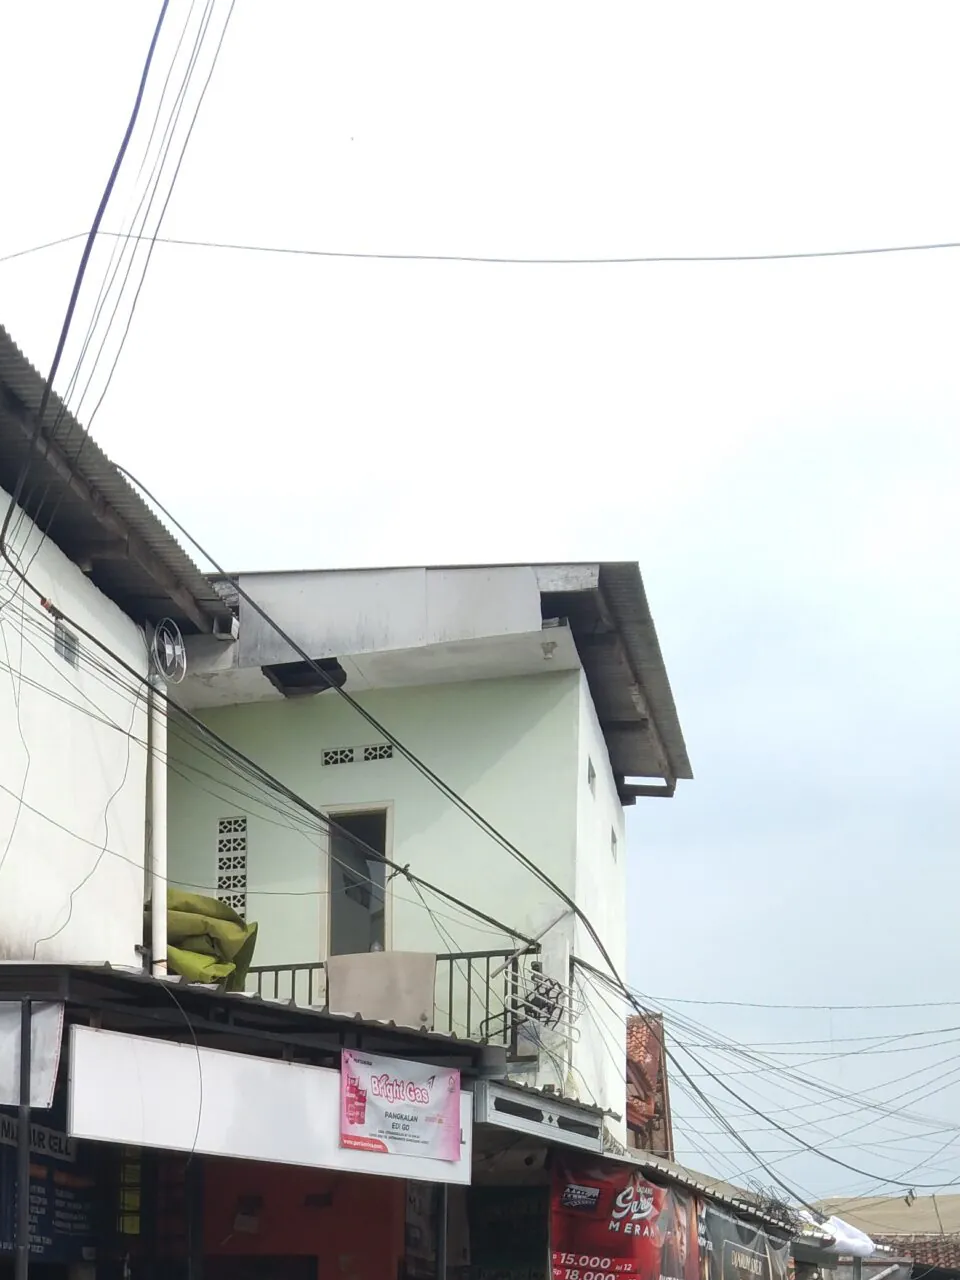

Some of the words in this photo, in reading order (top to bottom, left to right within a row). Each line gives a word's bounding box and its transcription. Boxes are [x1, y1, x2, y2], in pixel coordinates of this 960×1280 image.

[371, 1073, 405, 1104] Bright
[405, 1081, 430, 1105] Gas
[384, 1111, 418, 1123] PANGKALAN
[623, 1263, 632, 1271] 12
